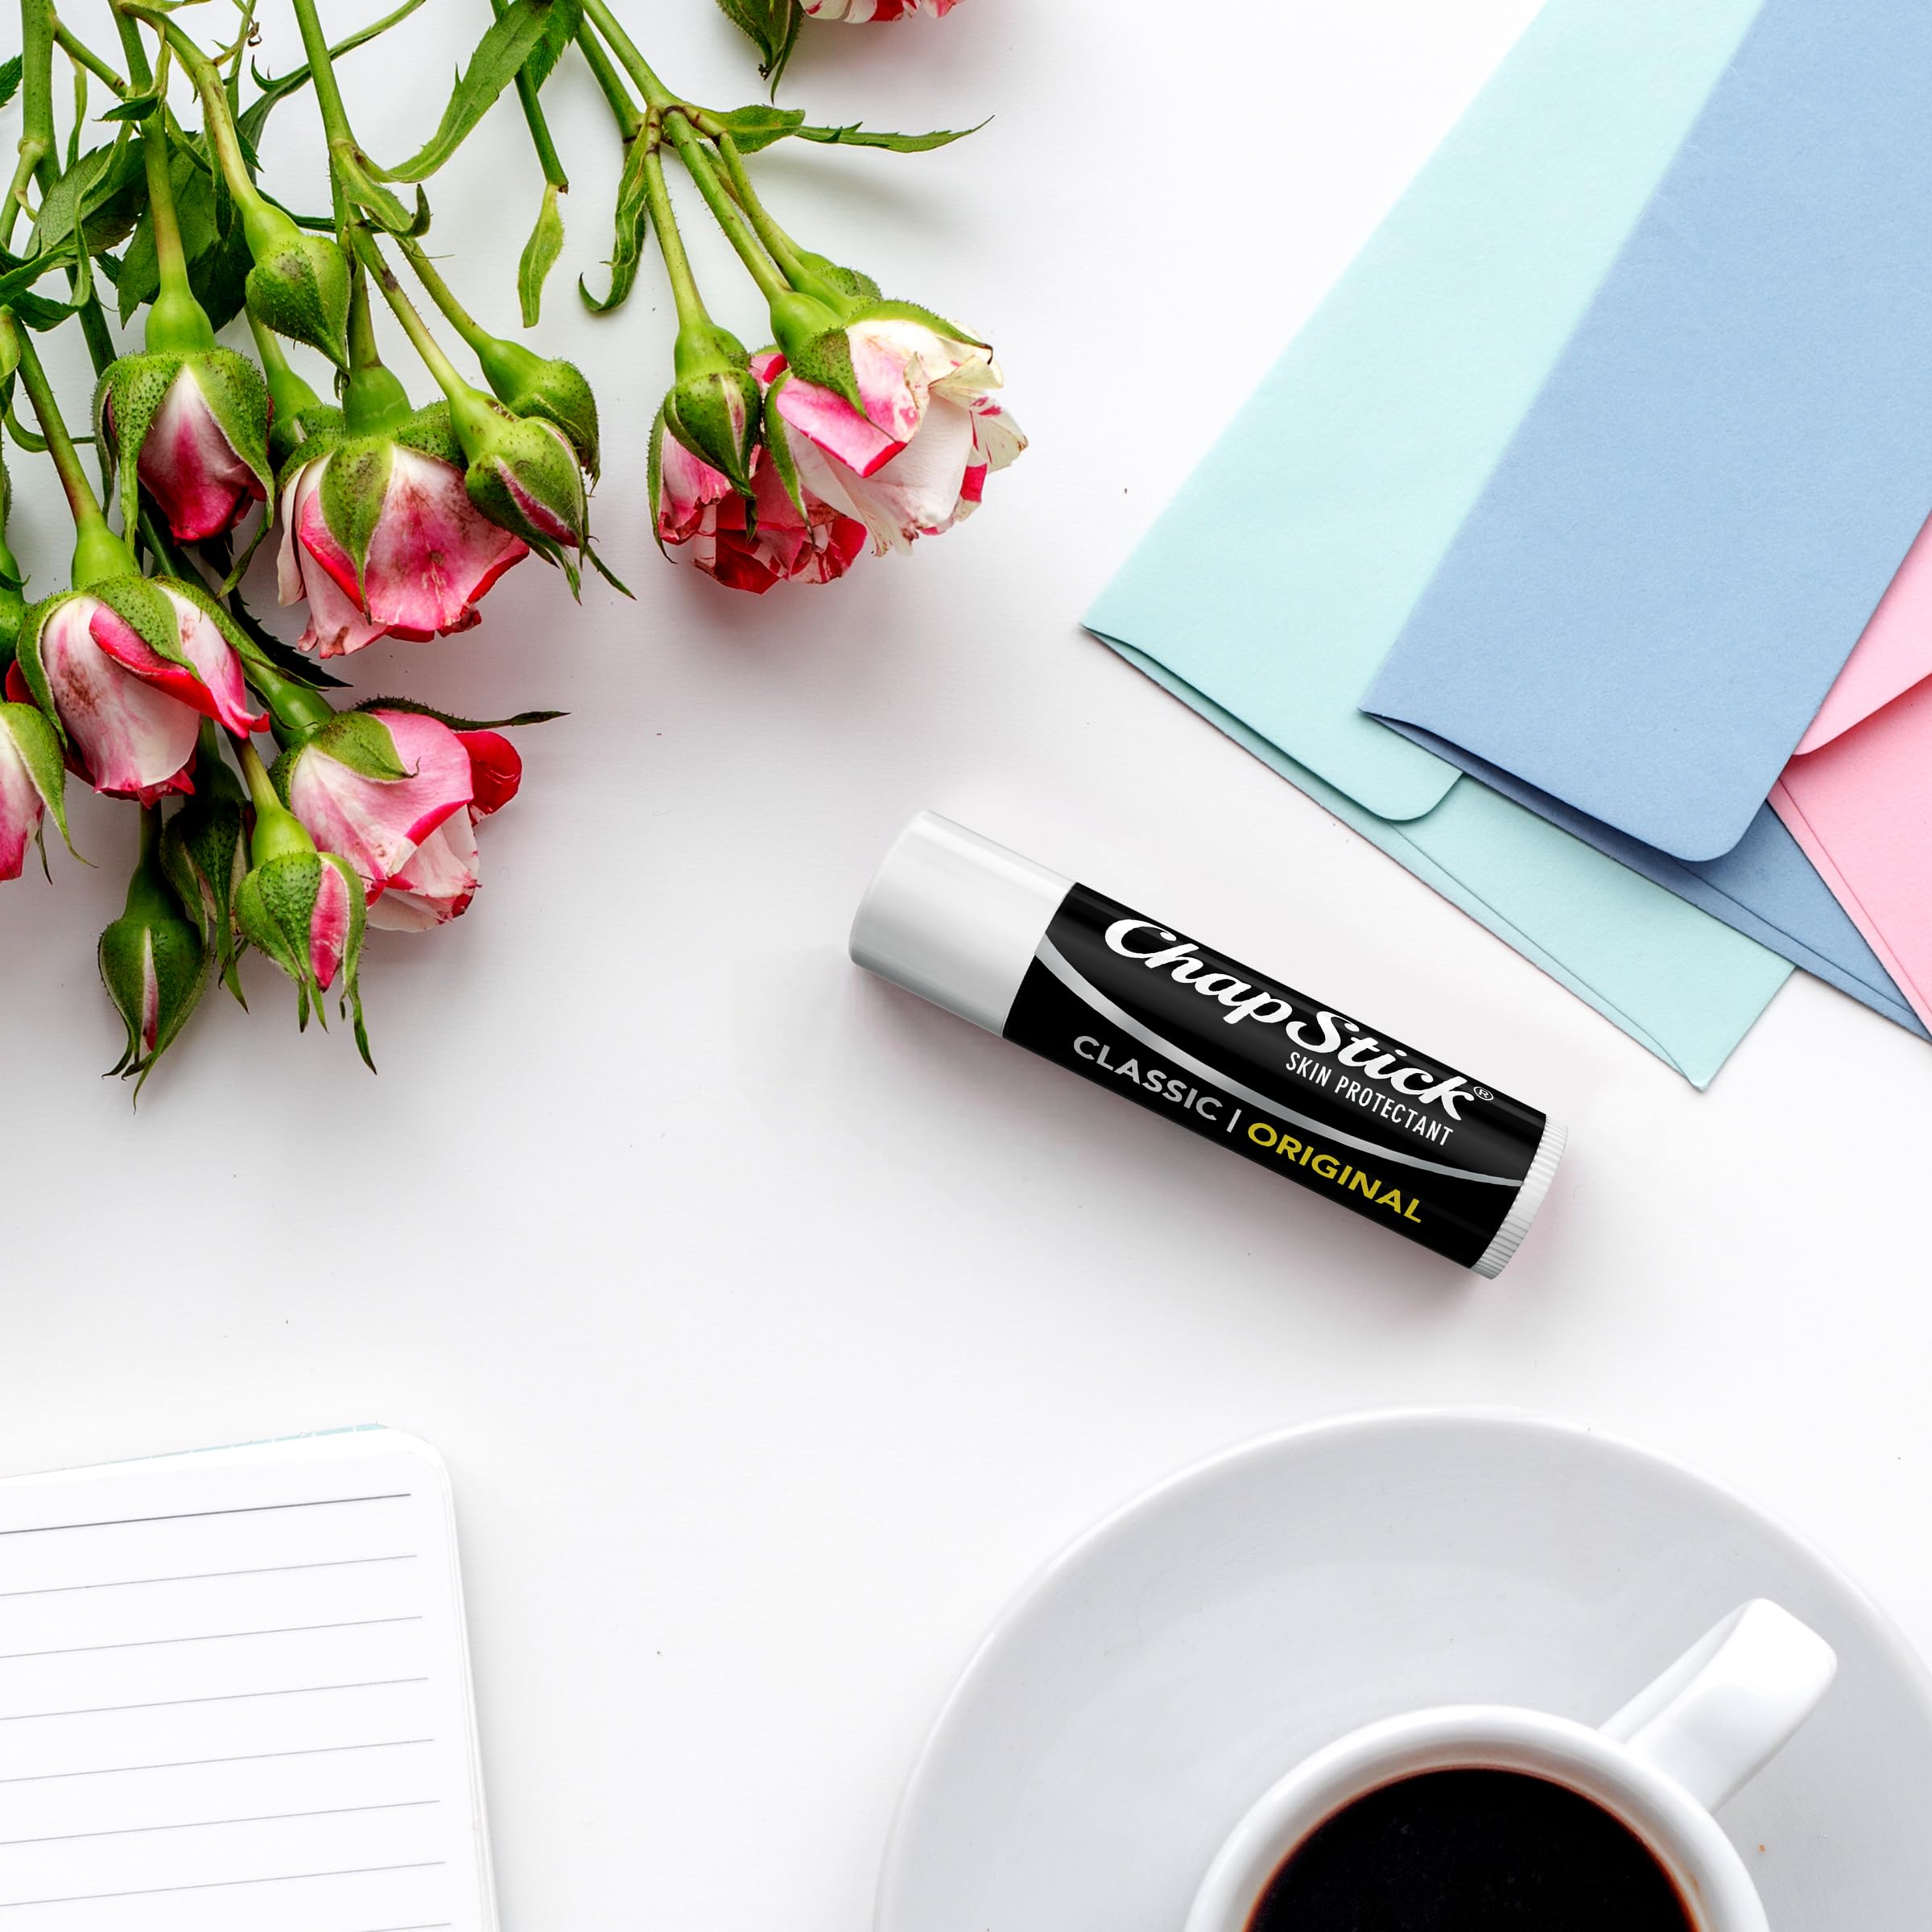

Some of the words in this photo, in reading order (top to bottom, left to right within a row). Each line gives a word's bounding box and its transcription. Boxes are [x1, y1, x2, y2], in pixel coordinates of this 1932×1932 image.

[1073, 1035, 1223, 1121] CLASSIC
[1248, 1122, 1422, 1224] ORIGINAL
[1286, 1051, 1332, 1087] SKIN
[1334, 1075, 1455, 1146] PROTECTANT
